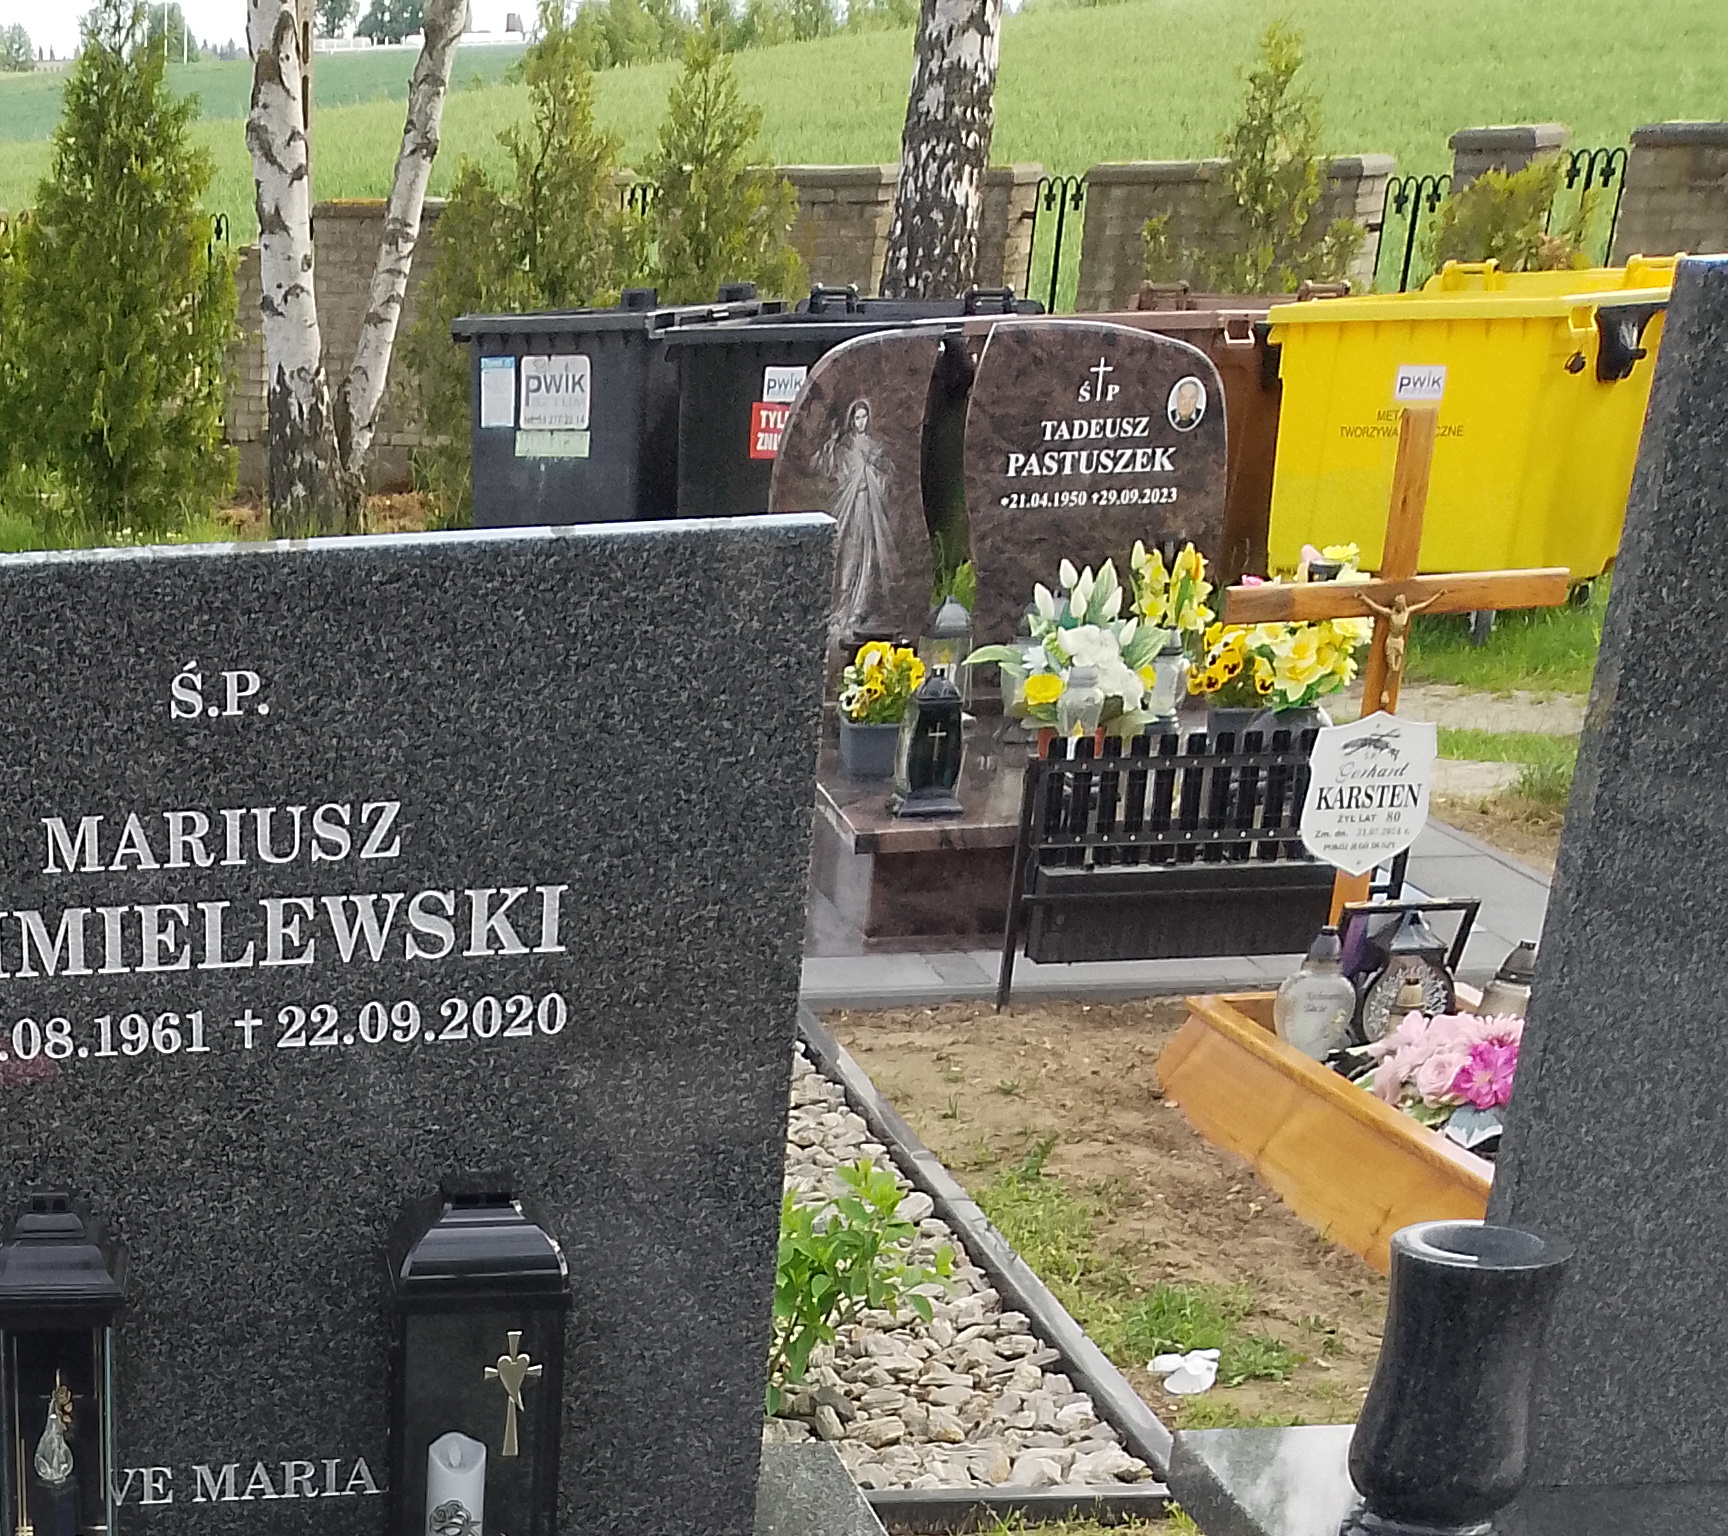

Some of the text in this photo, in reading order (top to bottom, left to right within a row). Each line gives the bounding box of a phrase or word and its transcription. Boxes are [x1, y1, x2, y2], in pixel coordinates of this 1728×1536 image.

[756, 432, 781, 451] ZNI
[1041, 416, 1150, 441] TADEUSZ
[1340, 425, 1466, 438] TWORZYWA CZNE
[1006, 447, 1177, 477] PASTUSZEK
[169, 661, 271, 720] Ś.P.
[1315, 783, 1423, 811] KARSTEN
[1358, 814, 1377, 822] LAT
[41, 801, 403, 875] MARIUSZ
[276, 992, 568, 1050] 22.09.2020
[110, 1456, 389, 1507] VE MARIA
